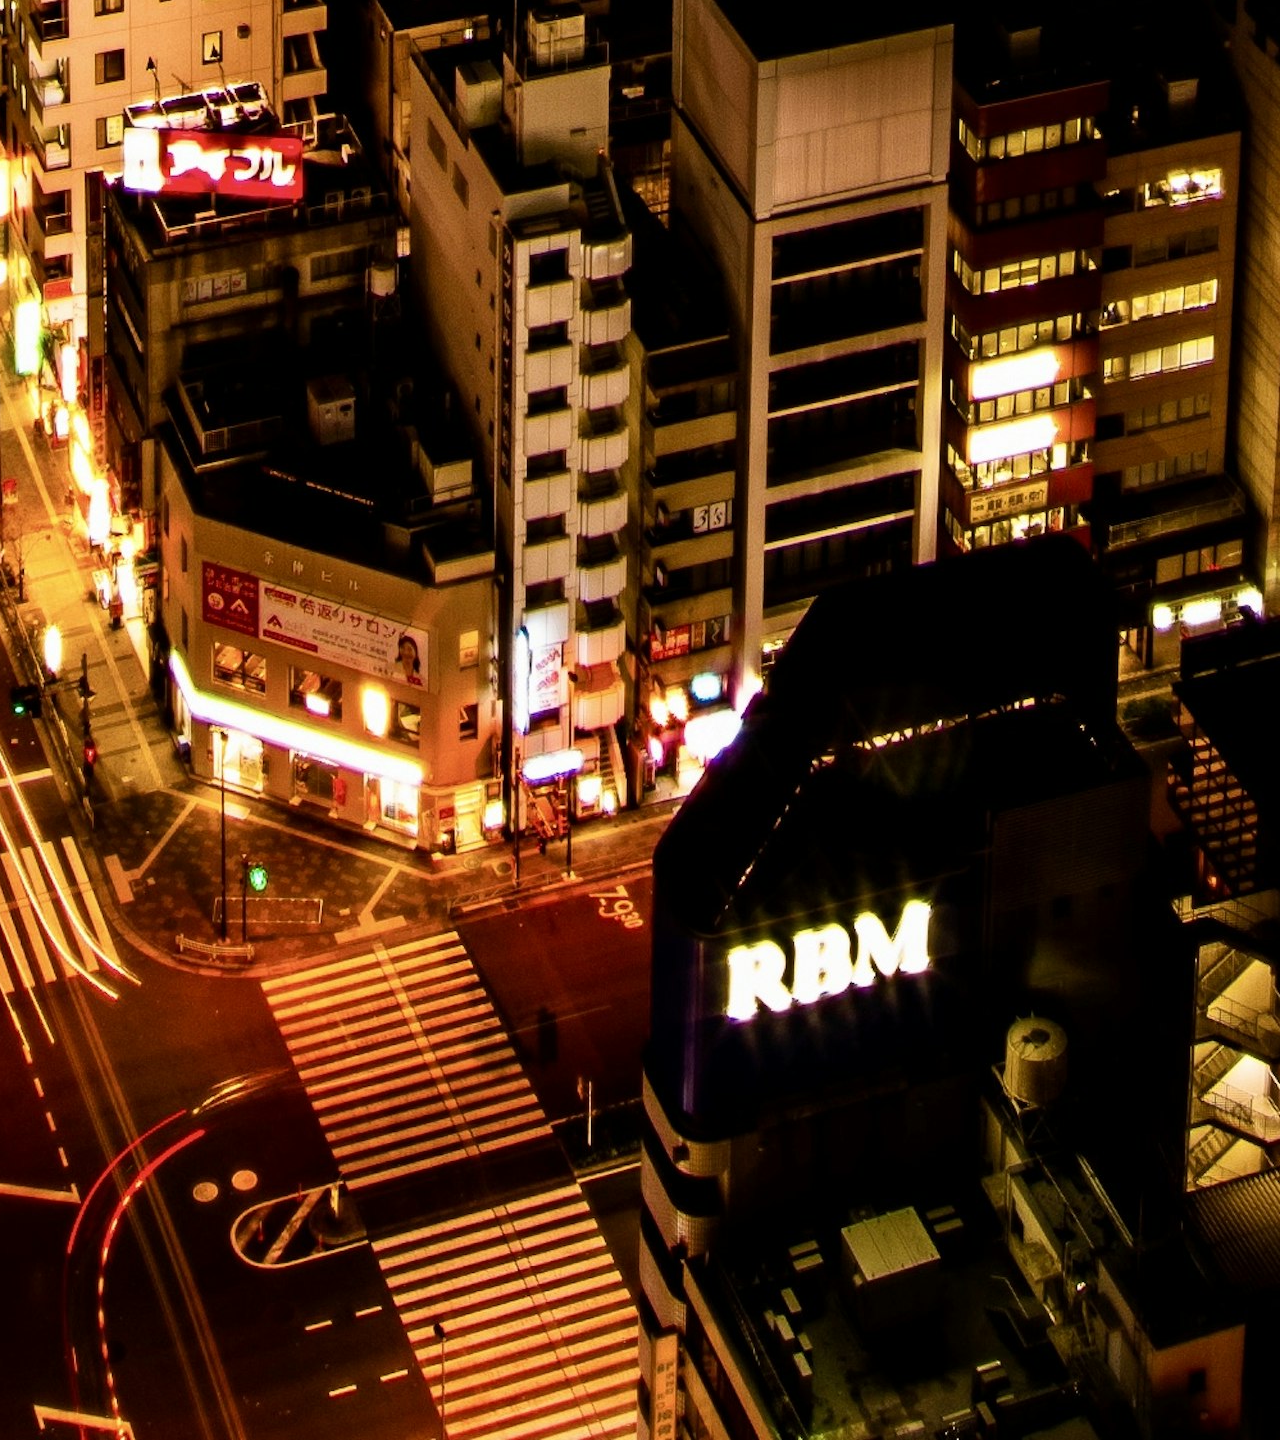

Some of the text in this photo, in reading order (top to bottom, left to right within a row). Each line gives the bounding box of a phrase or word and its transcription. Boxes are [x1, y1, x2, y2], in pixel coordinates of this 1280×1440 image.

[167, 141, 296, 187] アイフル
[696, 506, 724, 527] 3's
[299, 596, 398, 639] 若返りサロン
[725, 898, 932, 1022] RBM
